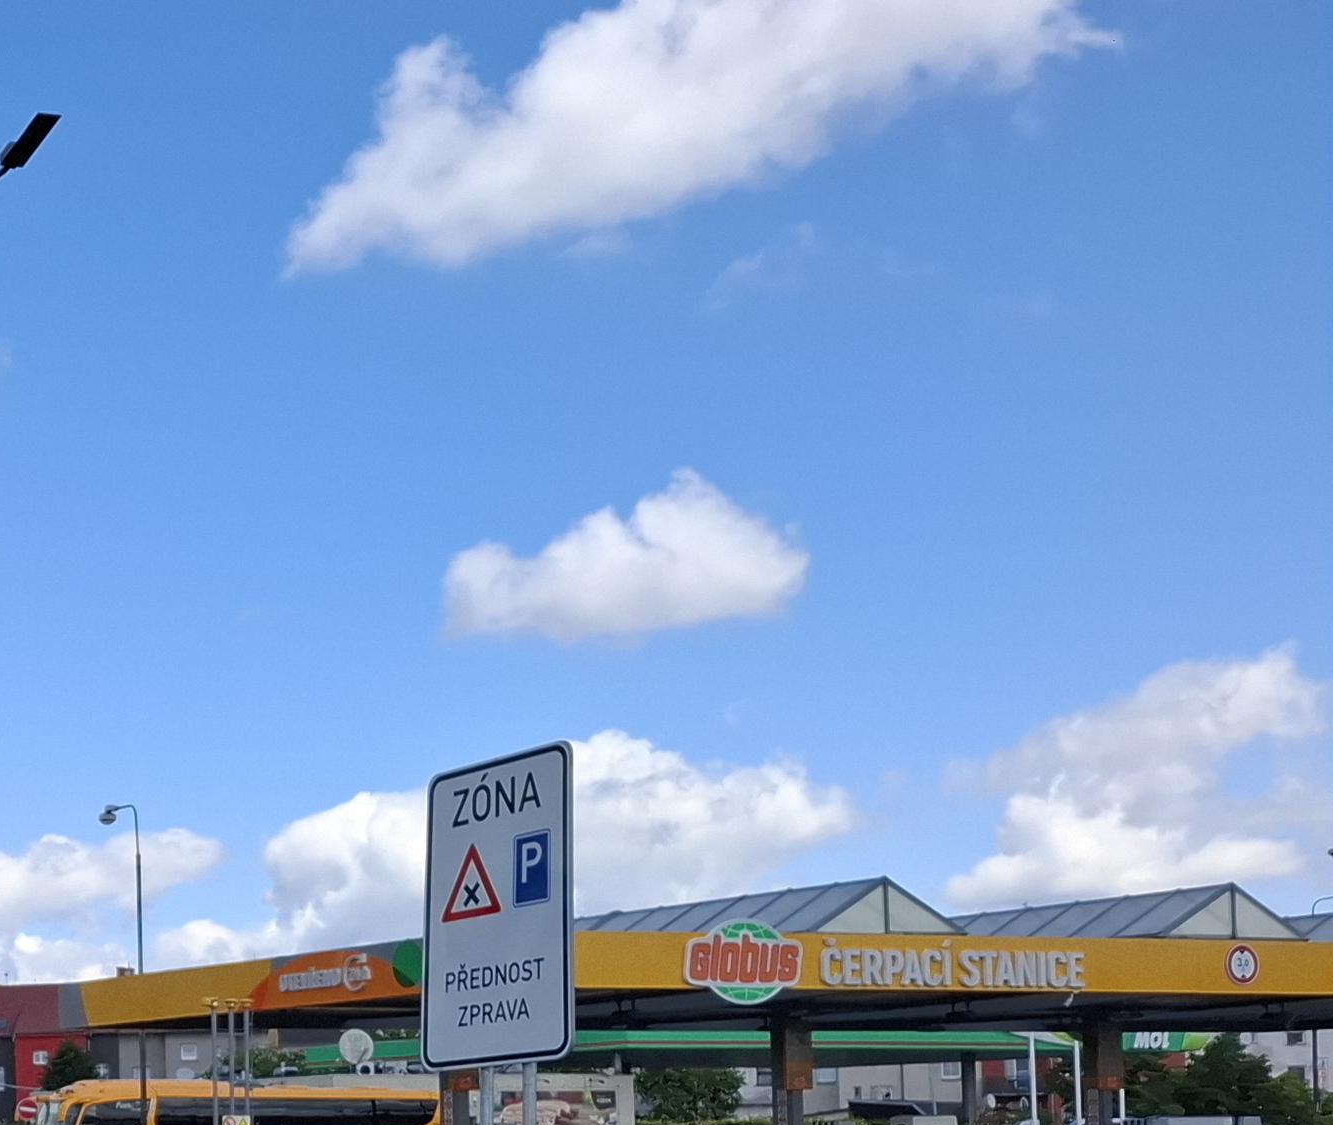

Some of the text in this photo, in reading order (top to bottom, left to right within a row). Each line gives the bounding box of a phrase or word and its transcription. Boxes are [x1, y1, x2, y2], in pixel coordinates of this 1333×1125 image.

[452, 771, 541, 828] ZÓNA
[520, 841, 543, 884] P
[444, 957, 545, 993] PŘEDNOST
[689, 933, 800, 983] Globus
[820, 937, 1086, 988] ČERPACÍ STANICE
[457, 997, 530, 1027] ZPRAVA
[1134, 1031, 1171, 1049] MOL
